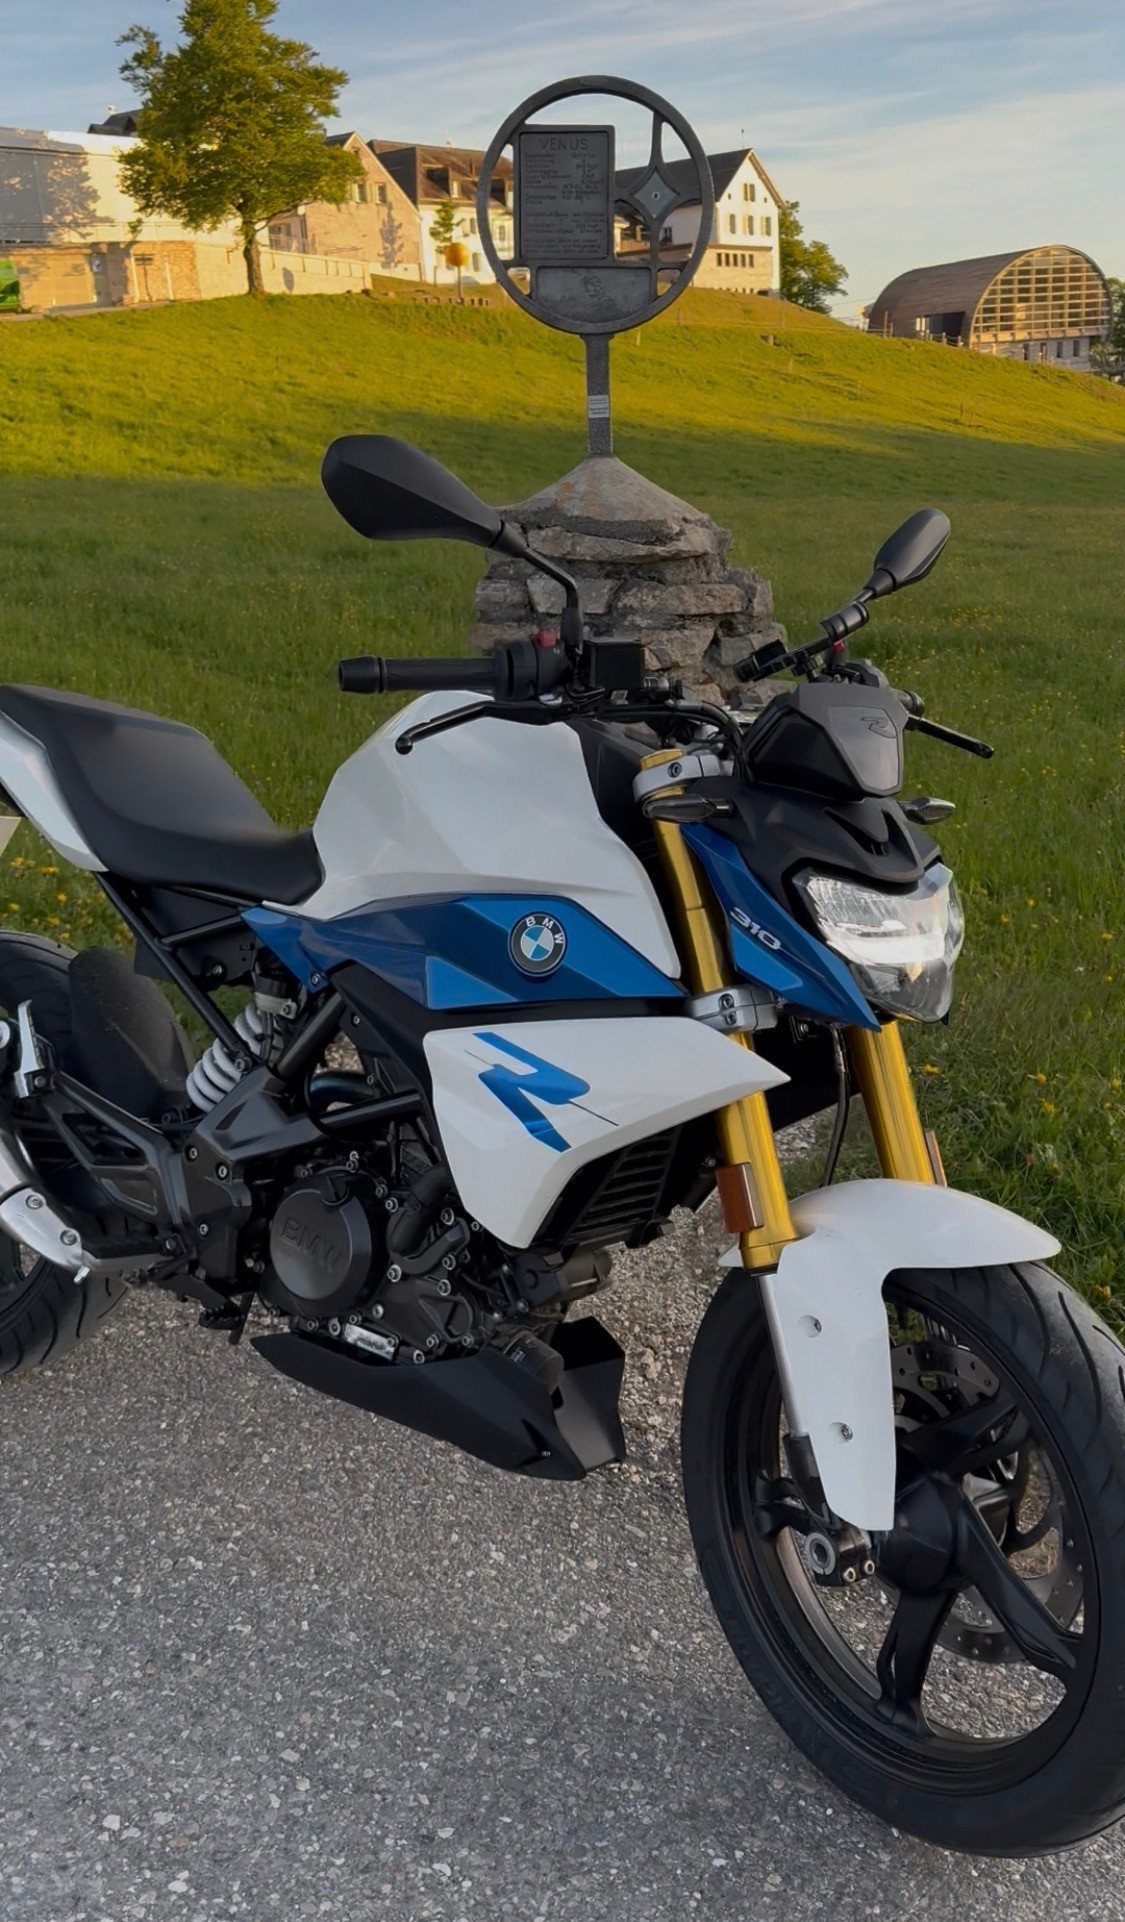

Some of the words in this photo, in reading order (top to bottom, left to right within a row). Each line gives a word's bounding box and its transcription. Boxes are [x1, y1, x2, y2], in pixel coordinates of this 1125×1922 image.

[540, 138, 588, 150] VENUS
[525, 916, 564, 944] BMW
[729, 906, 781, 950] 310
[281, 1216, 344, 1273] BMW
